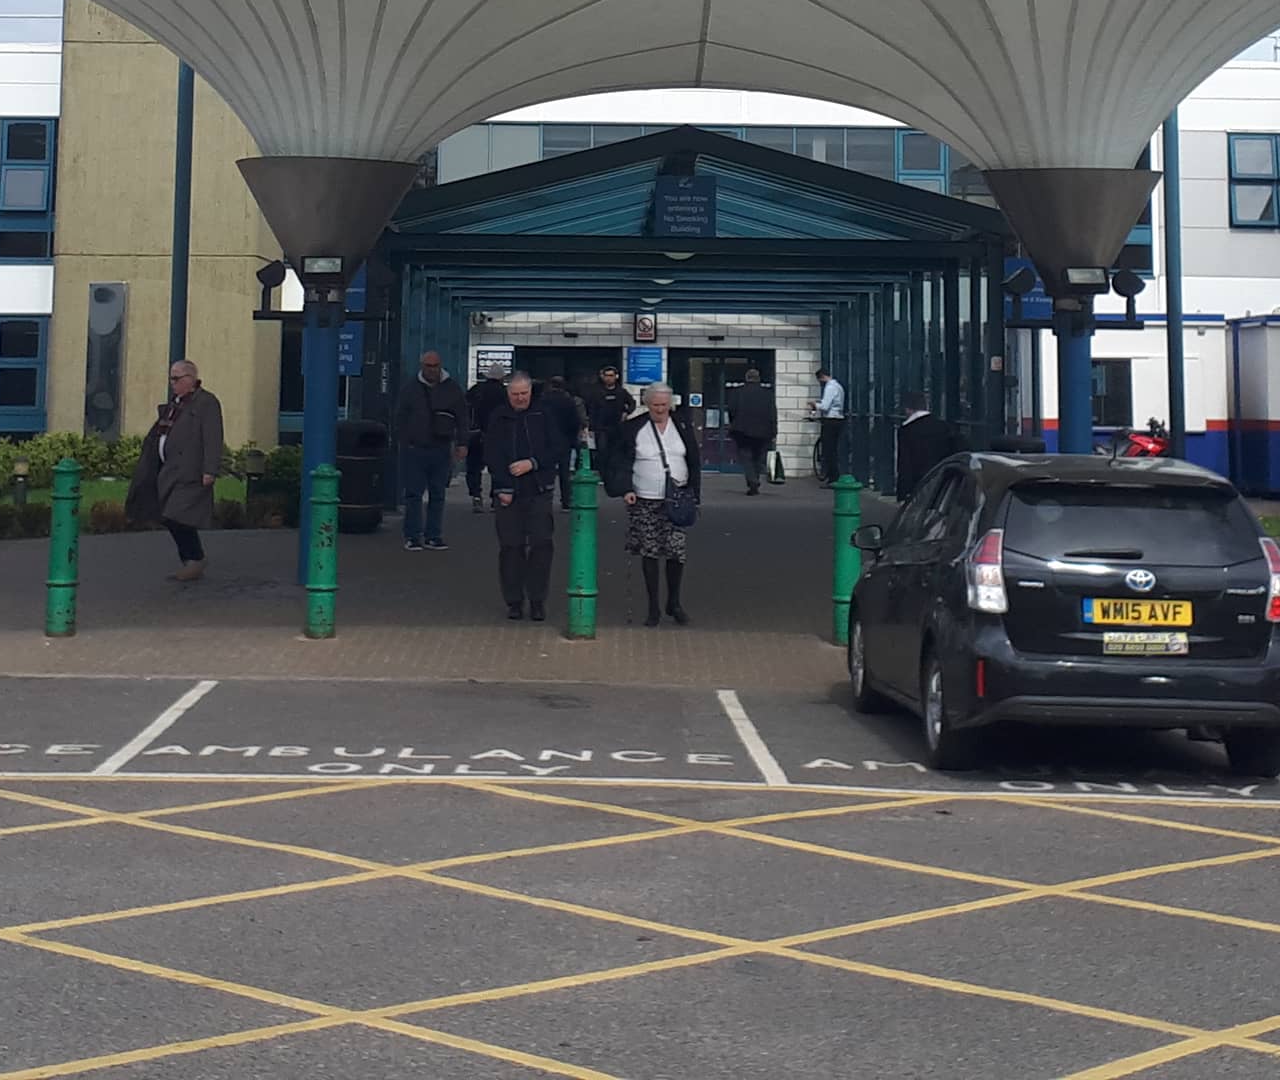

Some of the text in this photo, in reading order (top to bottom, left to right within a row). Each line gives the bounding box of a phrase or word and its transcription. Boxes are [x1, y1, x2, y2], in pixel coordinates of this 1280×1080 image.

[1100, 602, 1183, 622] WM15 AVF
[144, 744, 734, 766] AMBULANCE
[308, 762, 572, 776] ONLY
[999, 780, 1260, 797] ONLY
